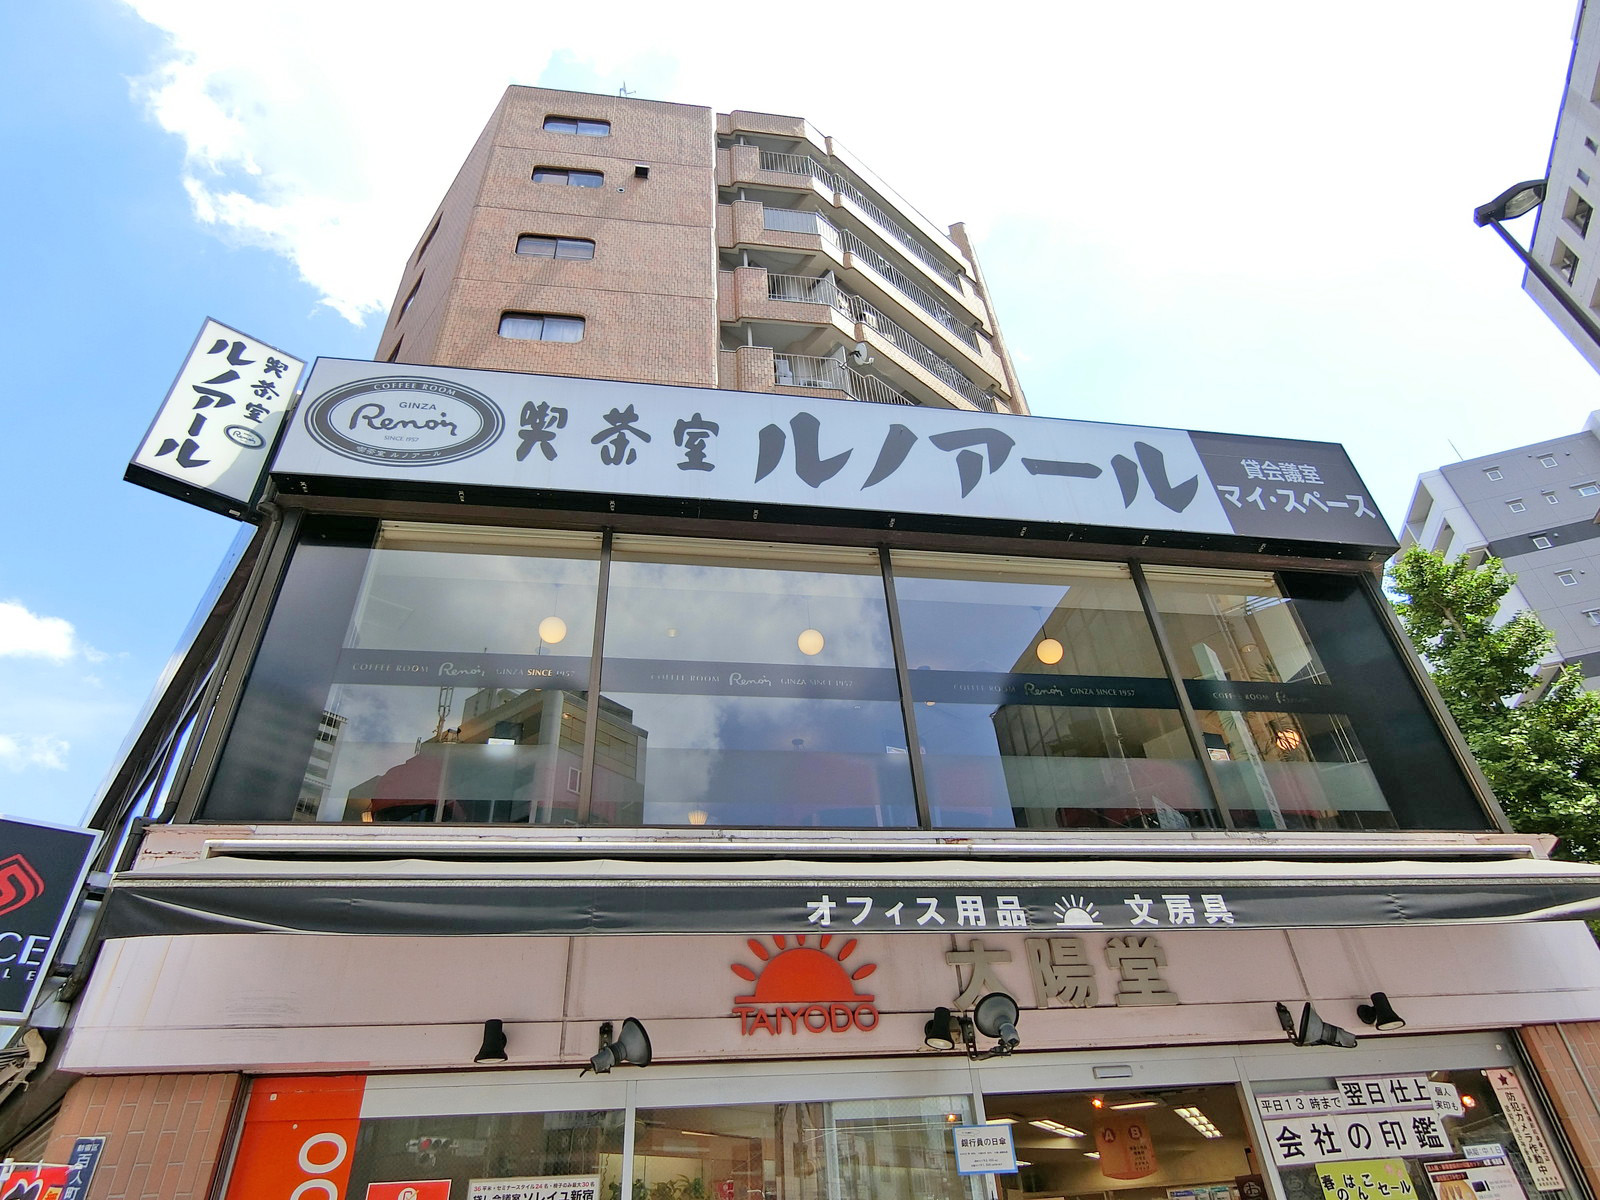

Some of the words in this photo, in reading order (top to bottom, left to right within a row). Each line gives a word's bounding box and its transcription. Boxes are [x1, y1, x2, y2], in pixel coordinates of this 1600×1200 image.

[154, 338, 256, 469] ルノアール
[243, 355, 289, 424] 喫茶室
[373, 382, 416, 391] COFFEE
[422, 383, 457, 396] ROOM
[399, 401, 437, 411] GINZA
[516, 401, 720, 472] 喫茶室
[754, 411, 1199, 514] ルノアール
[1240, 458, 1325, 485] 貸会議室
[1216, 484, 1377, 519] マイ・スペース
[527, 668, 553, 677] SINCE
[1070, 686, 1094, 695] GINZA
[806, 894, 1028, 928] オフィス用品
[1123, 892, 1236, 926] 文房具
[945, 935, 1182, 1012] 太陽堂
[732, 1004, 880, 1036] TAIYODO
[1341, 1078, 1432, 1109] 翌日仕上
[1434, 1086, 1452, 1097] 個人
[961, 1136, 1007, 1148] 銀行員の日傘
[1275, 1115, 1445, 1160] 会社の印鑑
